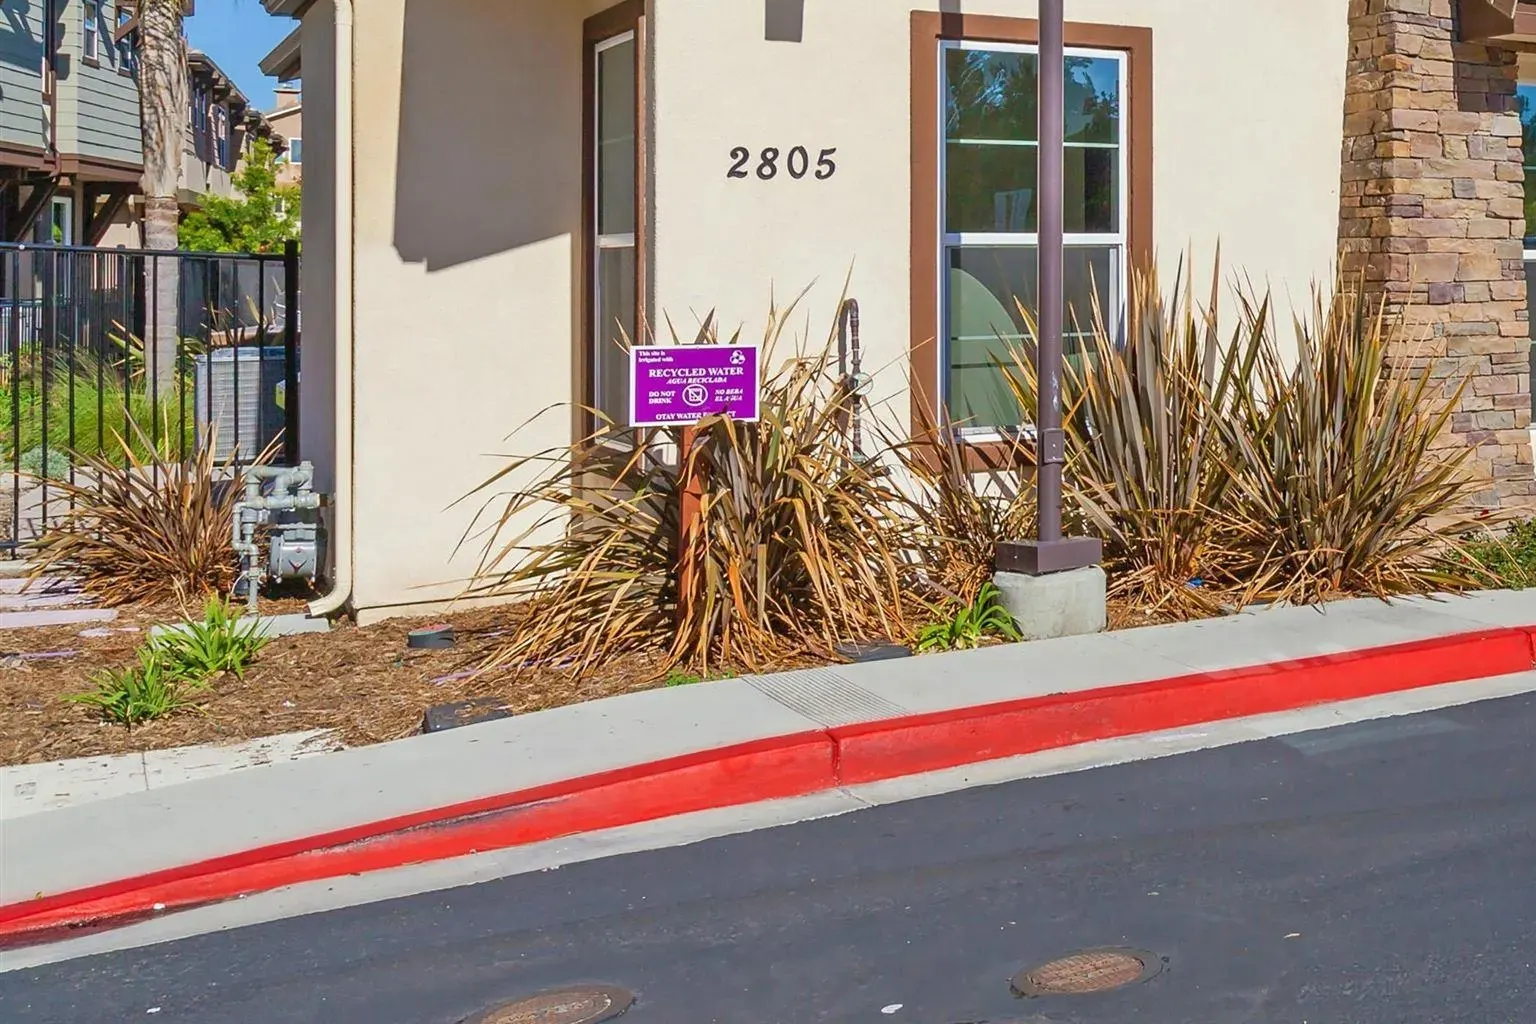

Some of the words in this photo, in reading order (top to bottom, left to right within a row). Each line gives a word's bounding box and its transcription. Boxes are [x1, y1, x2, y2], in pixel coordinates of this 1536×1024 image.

[726, 145, 837, 180] 2805
[648, 368, 706, 378] RECYCLED
[708, 367, 744, 376] WATER
